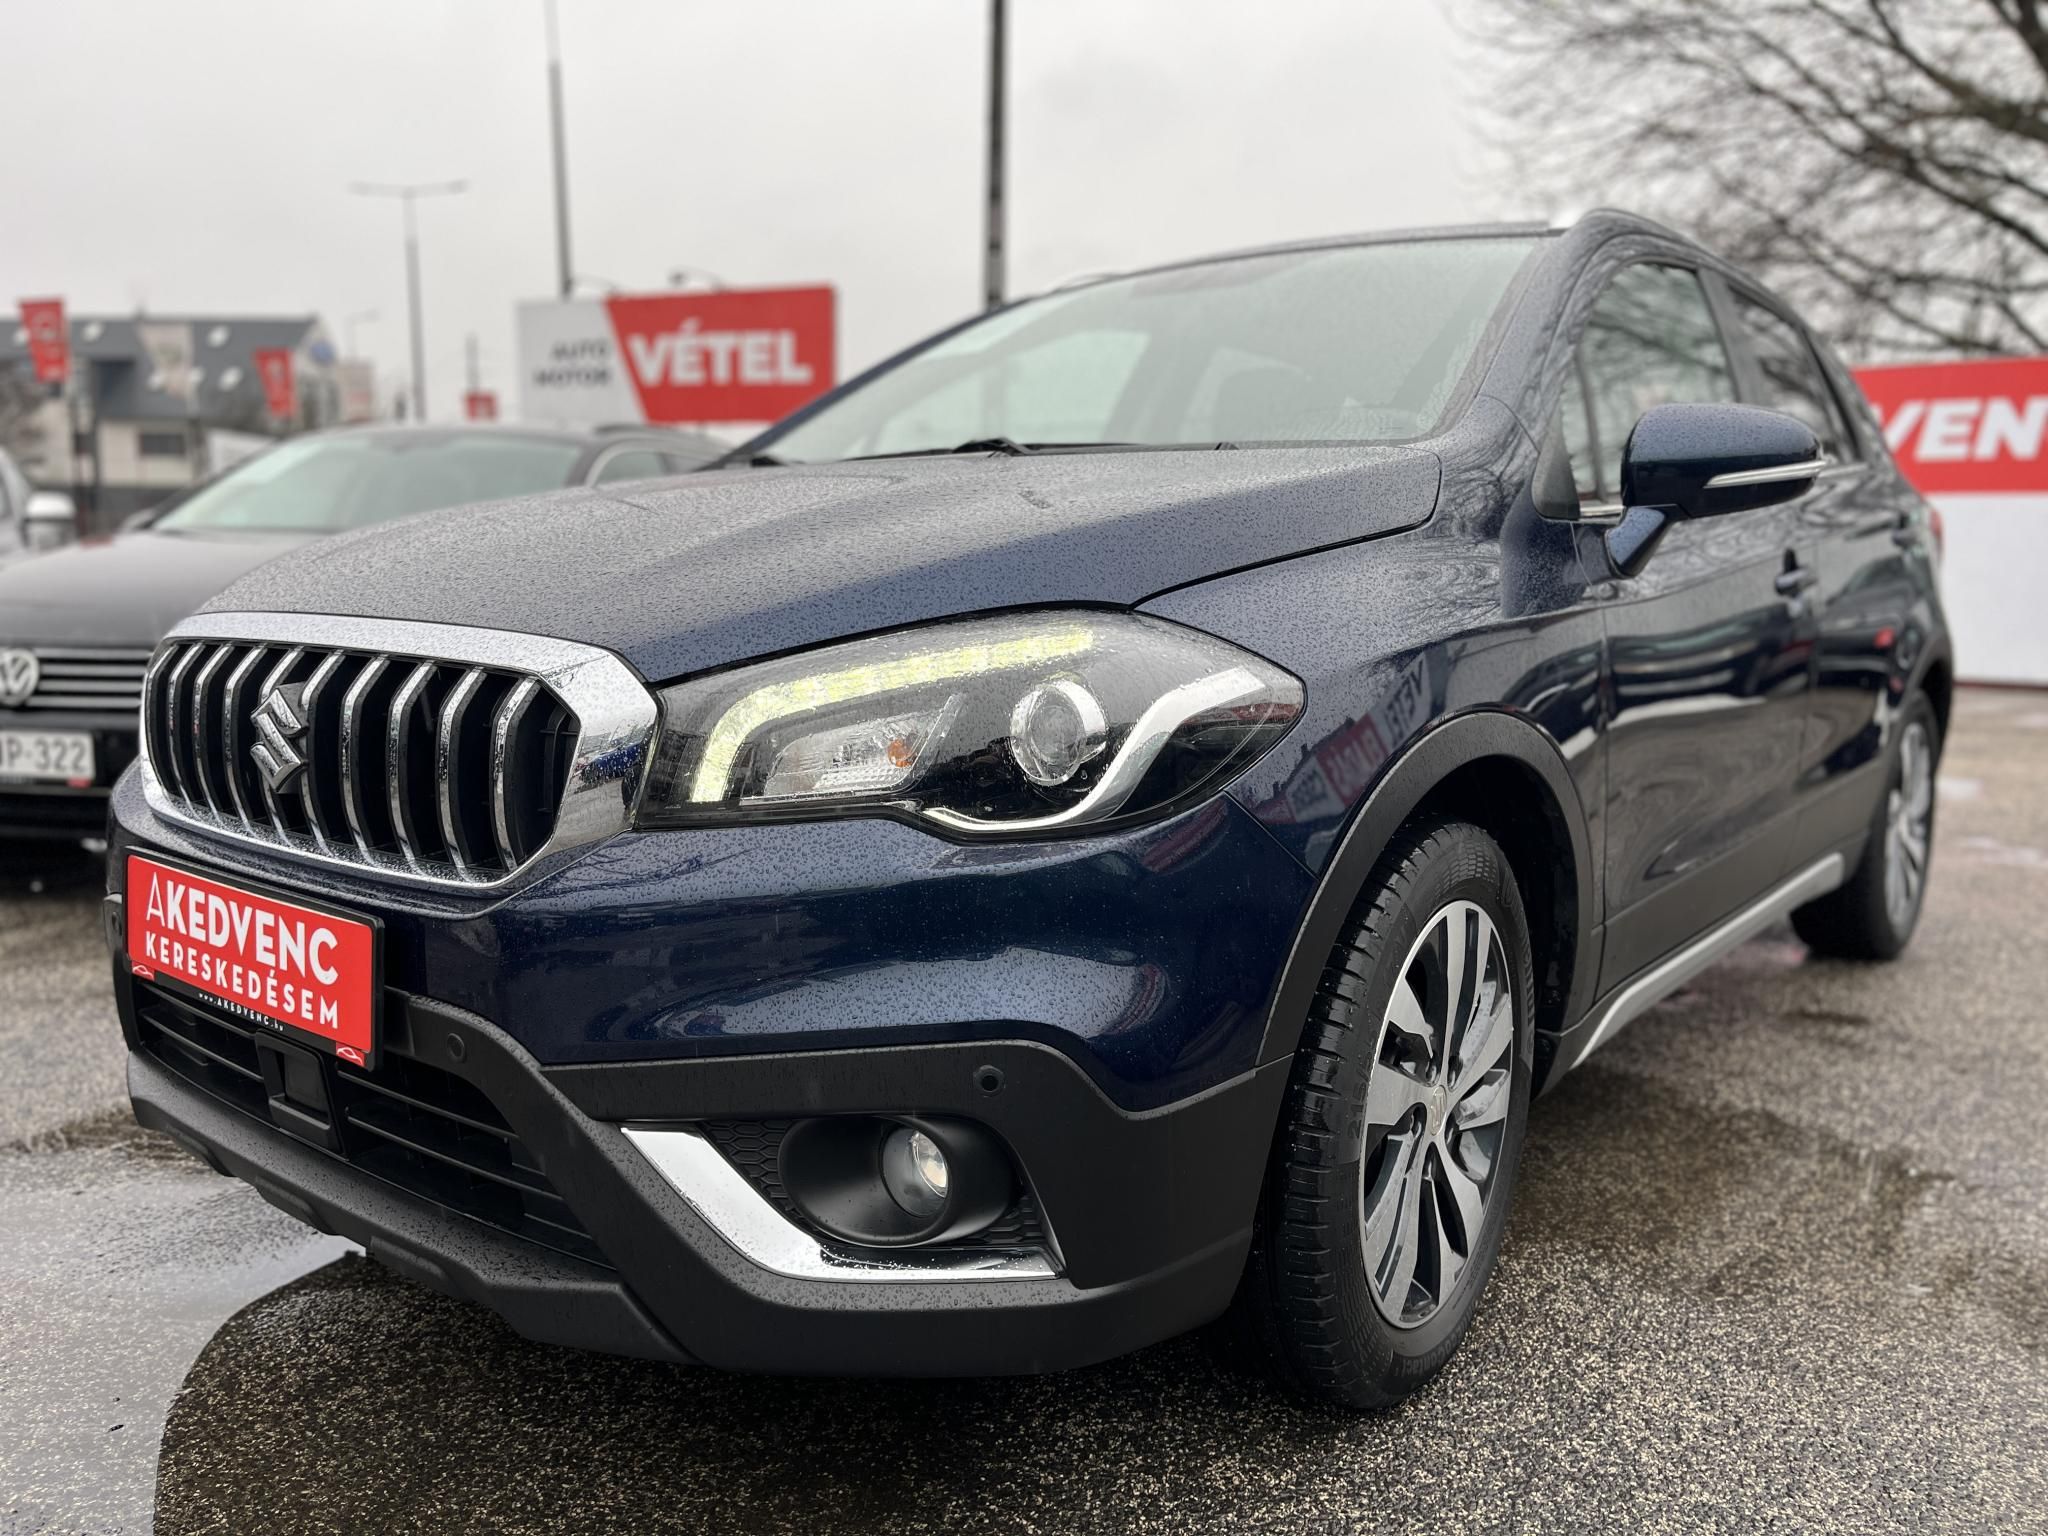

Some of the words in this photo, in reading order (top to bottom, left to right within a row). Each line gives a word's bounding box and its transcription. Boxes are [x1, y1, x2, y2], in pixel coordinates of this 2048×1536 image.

[627, 316, 813, 386] VÉTEL
[0, 736, 87, 772] P-322
[145, 930, 339, 1030] KERESKEDÉSEM
